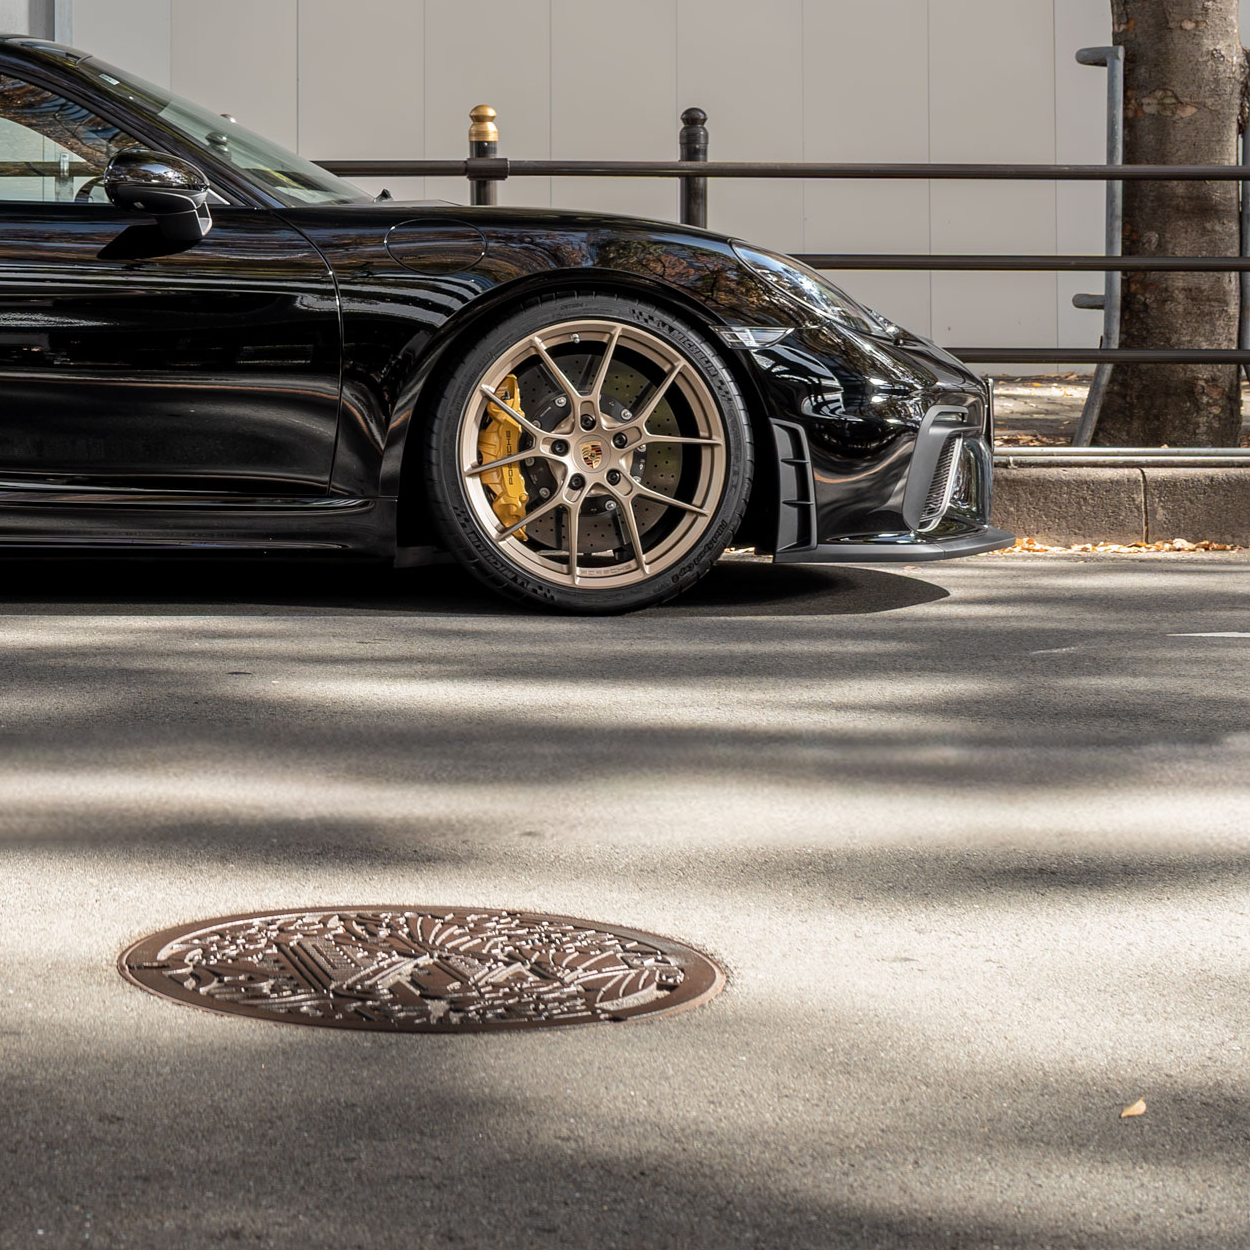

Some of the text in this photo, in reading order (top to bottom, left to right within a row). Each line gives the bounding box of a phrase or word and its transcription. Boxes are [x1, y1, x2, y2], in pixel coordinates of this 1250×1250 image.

[669, 329, 719, 377] MICHELIN
[505, 430, 514, 485] PORCHE
[466, 530, 516, 580] MICHELIN
